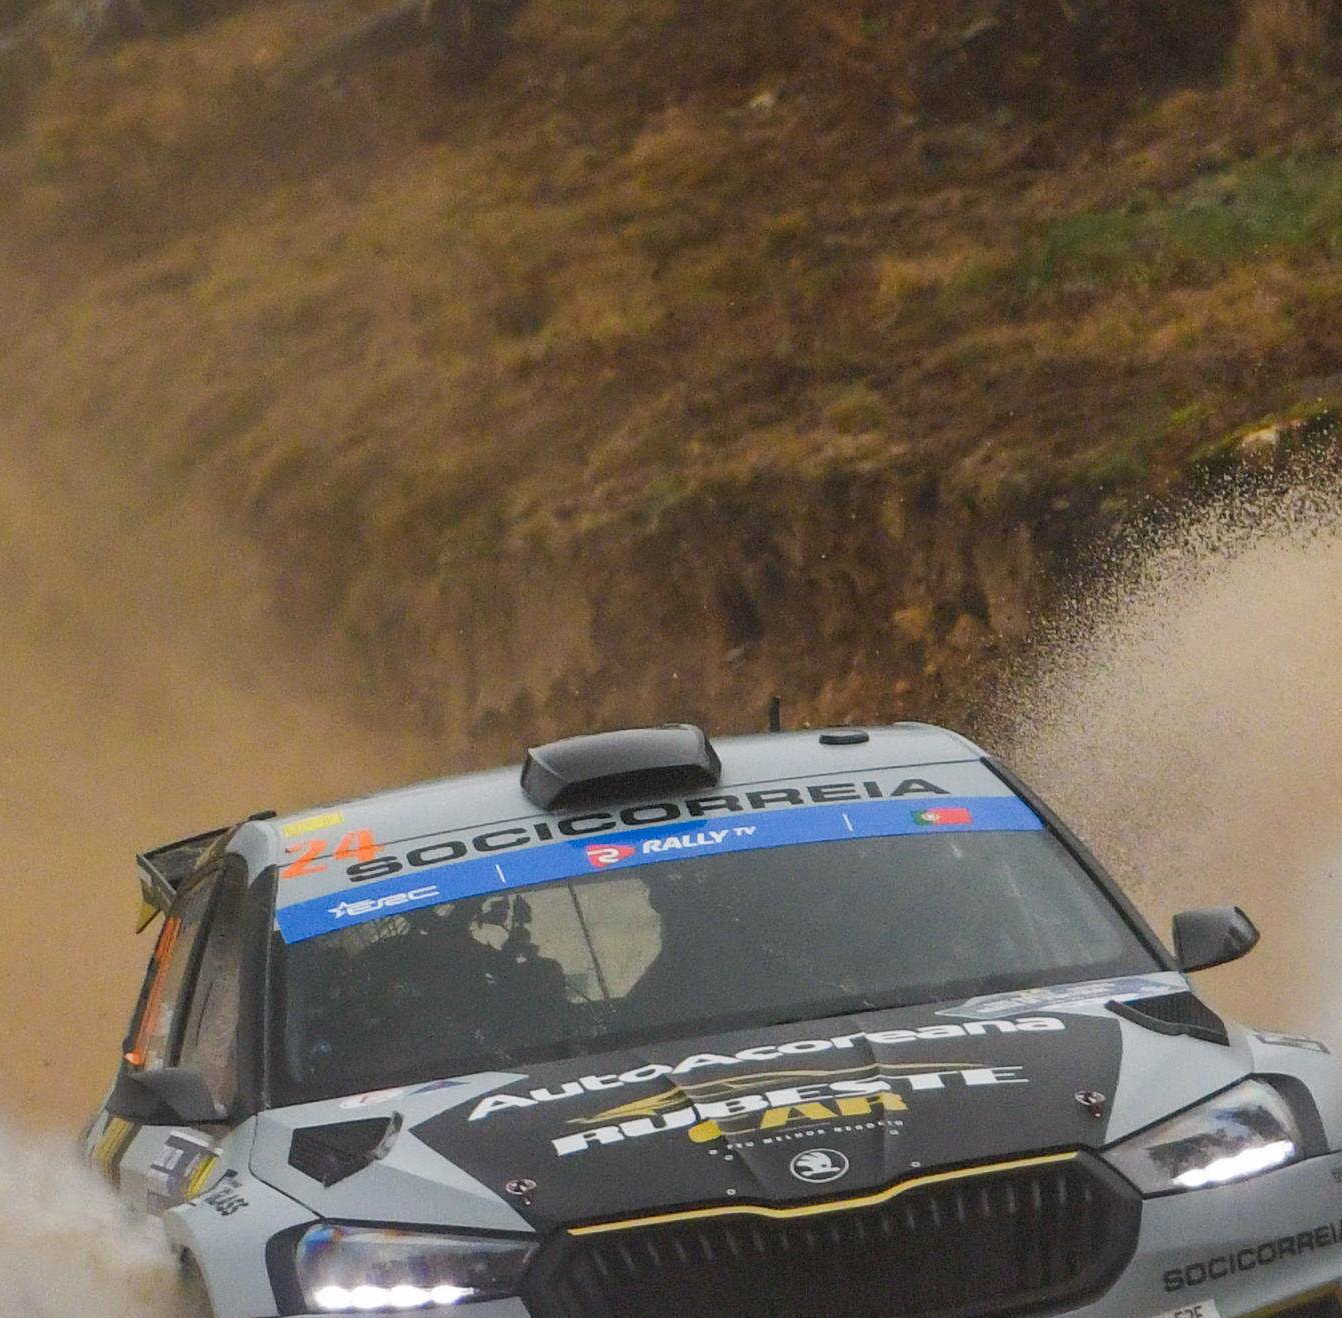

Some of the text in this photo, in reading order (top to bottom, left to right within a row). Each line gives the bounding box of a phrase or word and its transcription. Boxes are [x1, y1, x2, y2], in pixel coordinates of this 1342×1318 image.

[282, 827, 385, 879] 24
[346, 778, 950, 882] SOCICORREIA
[642, 825, 757, 854] RALLY TV
[345, 885, 440, 916] ERC
[550, 1065, 1030, 1157] RUBESTE
